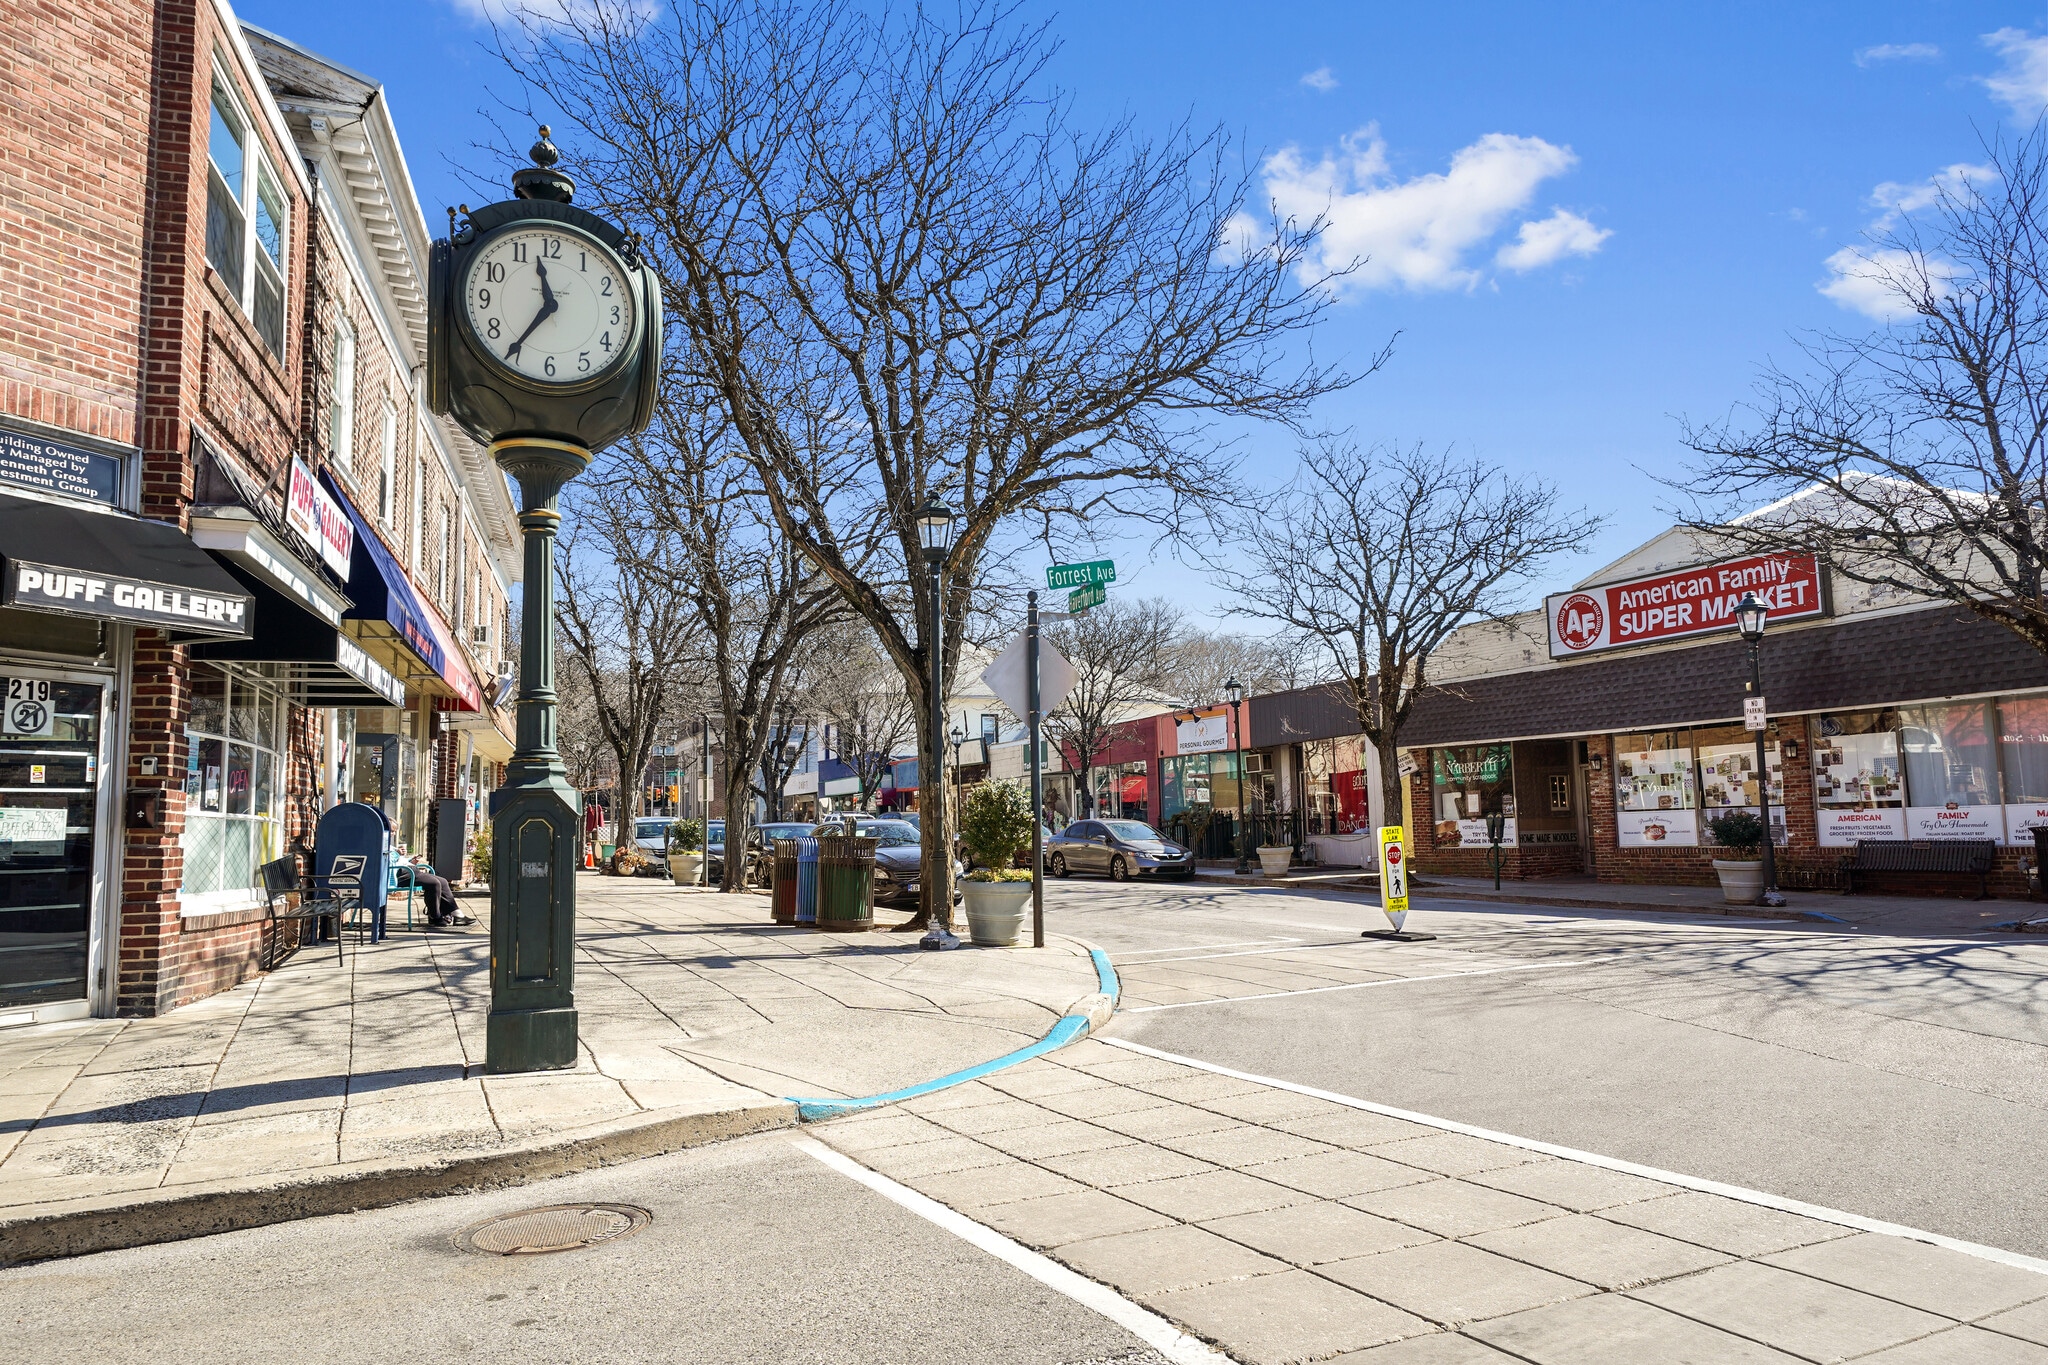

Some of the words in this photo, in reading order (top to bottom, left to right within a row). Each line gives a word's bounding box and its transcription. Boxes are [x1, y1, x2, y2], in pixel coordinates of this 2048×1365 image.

[512, 242, 528, 263] 11
[541, 238, 563, 259] 12
[485, 262, 505, 283] 10
[579, 252, 587, 272] 1
[600, 276, 613, 297] 2
[479, 289, 491, 309] 9
[610, 305, 620, 325] 3
[487, 318, 501, 339] 8
[600, 331, 612, 352] 4
[544, 356, 556, 377] 6
[577, 351, 591, 372] 5
[9, 448, 67, 469] Managed
[71, 462, 86, 474] by
[45, 446, 89, 464] Owned
[52, 469, 89, 485] Gross
[58, 481, 98, 498] Group
[291, 466, 314, 518] PUFF
[321, 502, 353, 561] GALLERY
[1048, 565, 1092, 586] Forrest
[1096, 567, 1115, 581] Ave
[1619, 575, 1712, 610] American
[1719, 560, 1790, 591] Family
[18, 568, 106, 603] PUFF
[113, 584, 244, 623] GALLERY
[1566, 609, 1596, 640] AF
[1619, 603, 1693, 636] SUPER
[10, 679, 49, 701] 219
[18, 709, 39, 727] 21
[1180, 741, 1202, 749] PERSONAL
[1203, 738, 1225, 746] GOURMET
[1446, 761, 1497, 775] NARBERTH
[229, 769, 249, 794] OPEN
[1837, 814, 1882, 822] AMERICAN
[1920, 820, 1933, 830] Try
[1934, 820, 1948, 829] Our
[1948, 820, 1989, 829] Homemade
[1937, 812, 1969, 820] FAMILY
[1519, 833, 1534, 844] HOME
[1536, 833, 1551, 843] MADE
[1552, 832, 1578, 843] NOODLES
[1388, 851, 1401, 860] STOP
